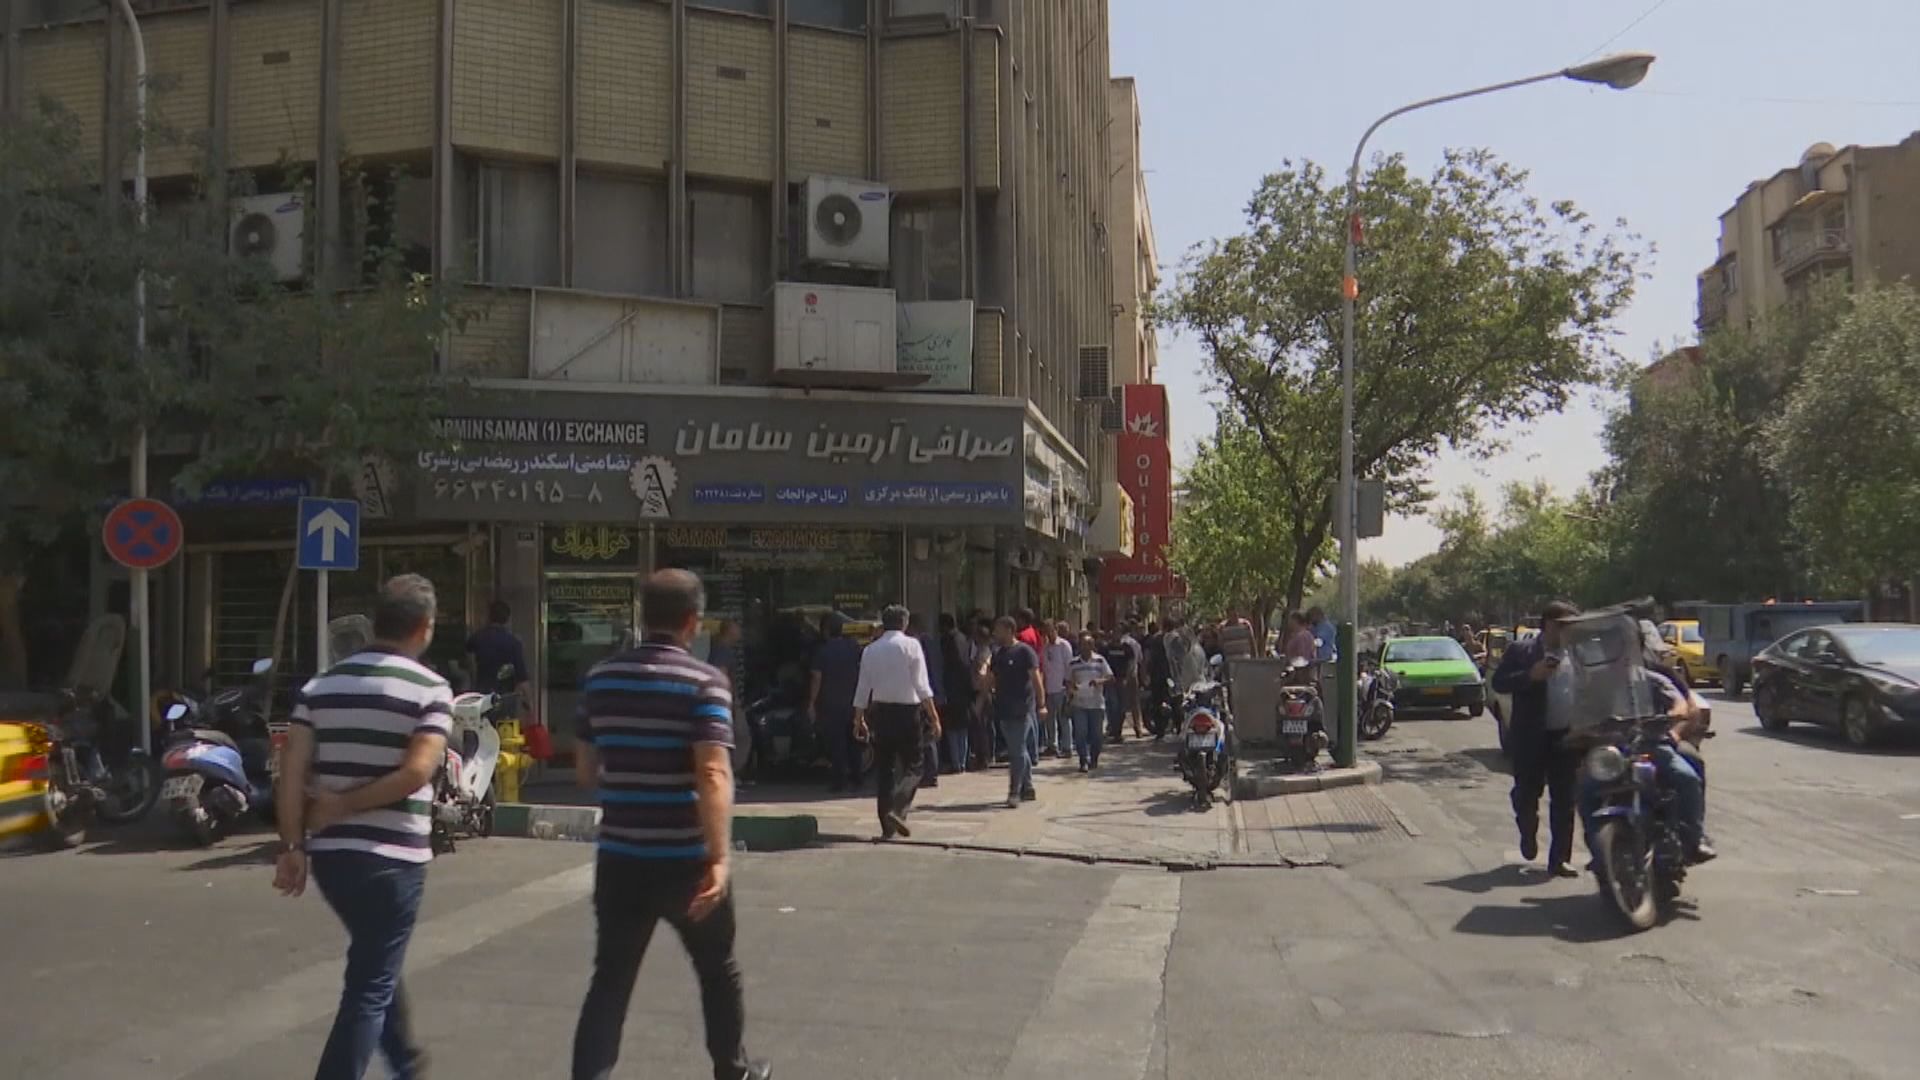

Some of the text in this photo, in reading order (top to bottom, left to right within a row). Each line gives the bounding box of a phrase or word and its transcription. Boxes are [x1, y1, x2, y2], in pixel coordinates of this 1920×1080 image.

[541, 420, 562, 442] (1)
[565, 422, 646, 443] EXCHANGE
[674, 416, 1014, 465] صرافی آرمین سامان
[864, 486, 1009, 504] با مجوز رسمی از بانک مرکزی
[1136, 453, 1151, 566] Outlet
